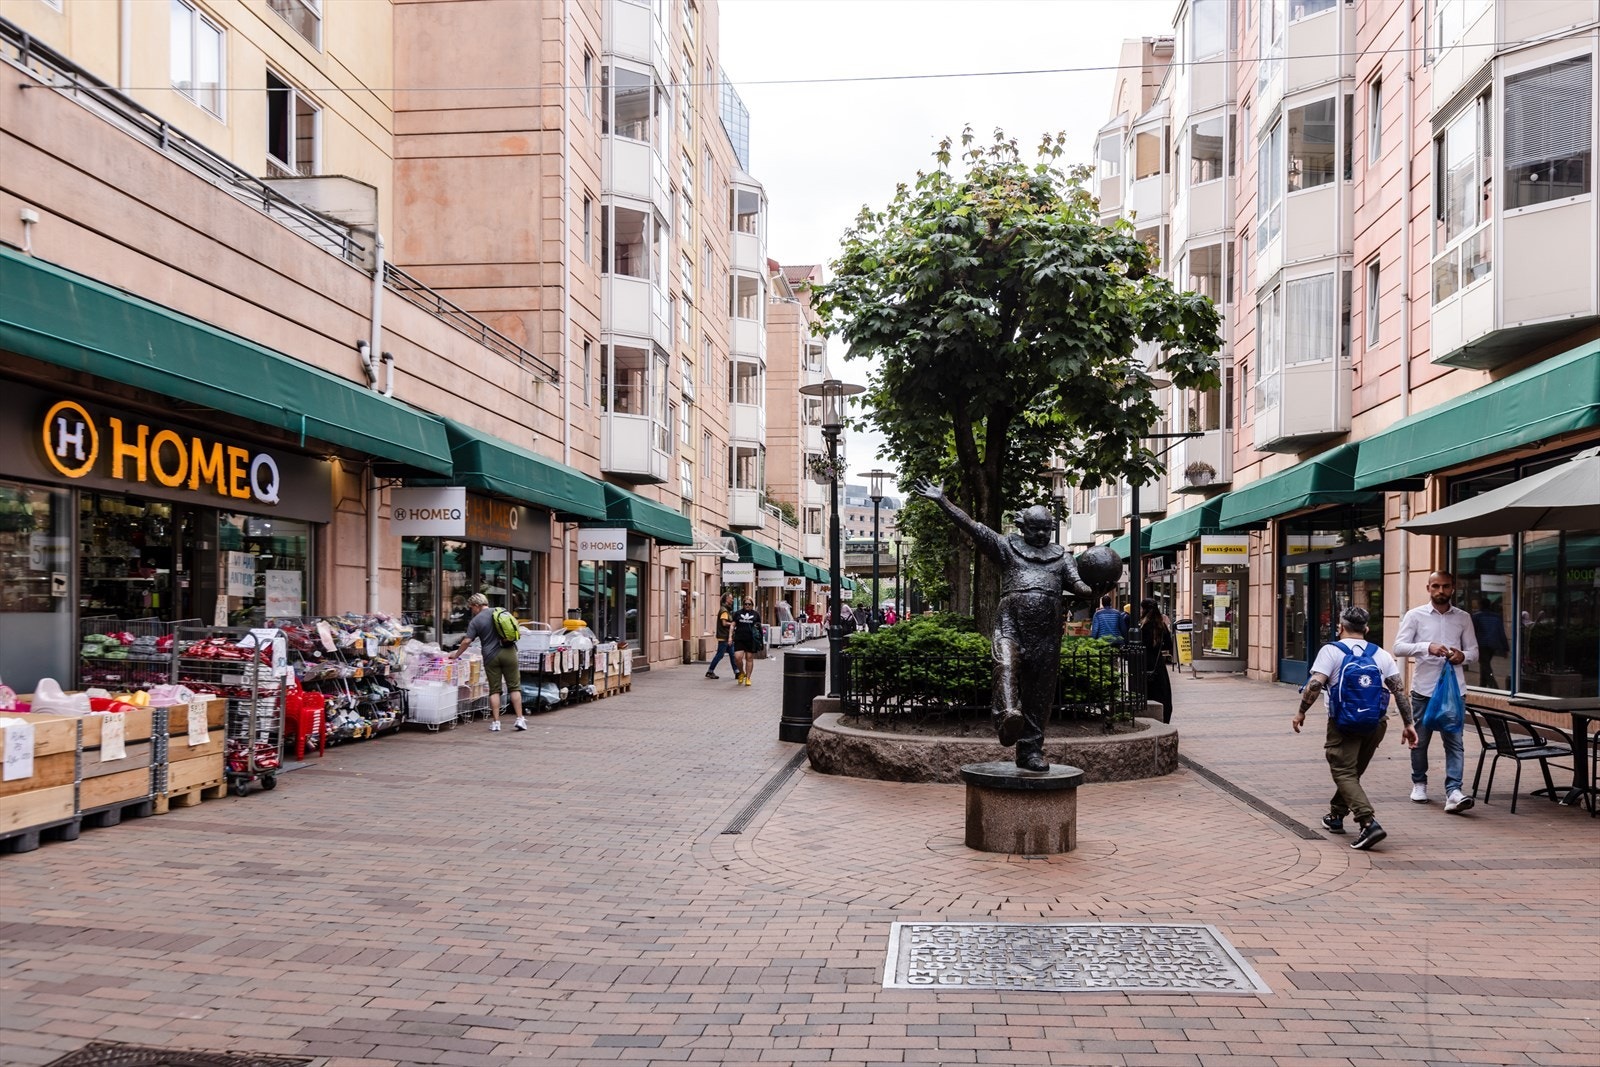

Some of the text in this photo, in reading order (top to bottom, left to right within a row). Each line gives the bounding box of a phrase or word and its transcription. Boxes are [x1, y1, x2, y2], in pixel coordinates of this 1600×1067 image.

[109, 416, 280, 505] HOMEQ
[409, 508, 461, 520] HOMEQ
[590, 542, 624, 550] HOMEQ
[972, 926, 1088, 934] DETTE
[1102, 926, 1198, 934] STED
[911, 936, 1017, 945] HOLDT
[911, 943, 1213, 953] ARMEEN SINE
[1065, 950, 1196, 959] MØTER
[910, 955, 1031, 965] NORGE
[1090, 957, 1224, 966] JANUAR
[910, 962, 1228, 973] 1888 VED KOM-
[1090, 971, 1236, 982] HANNA
